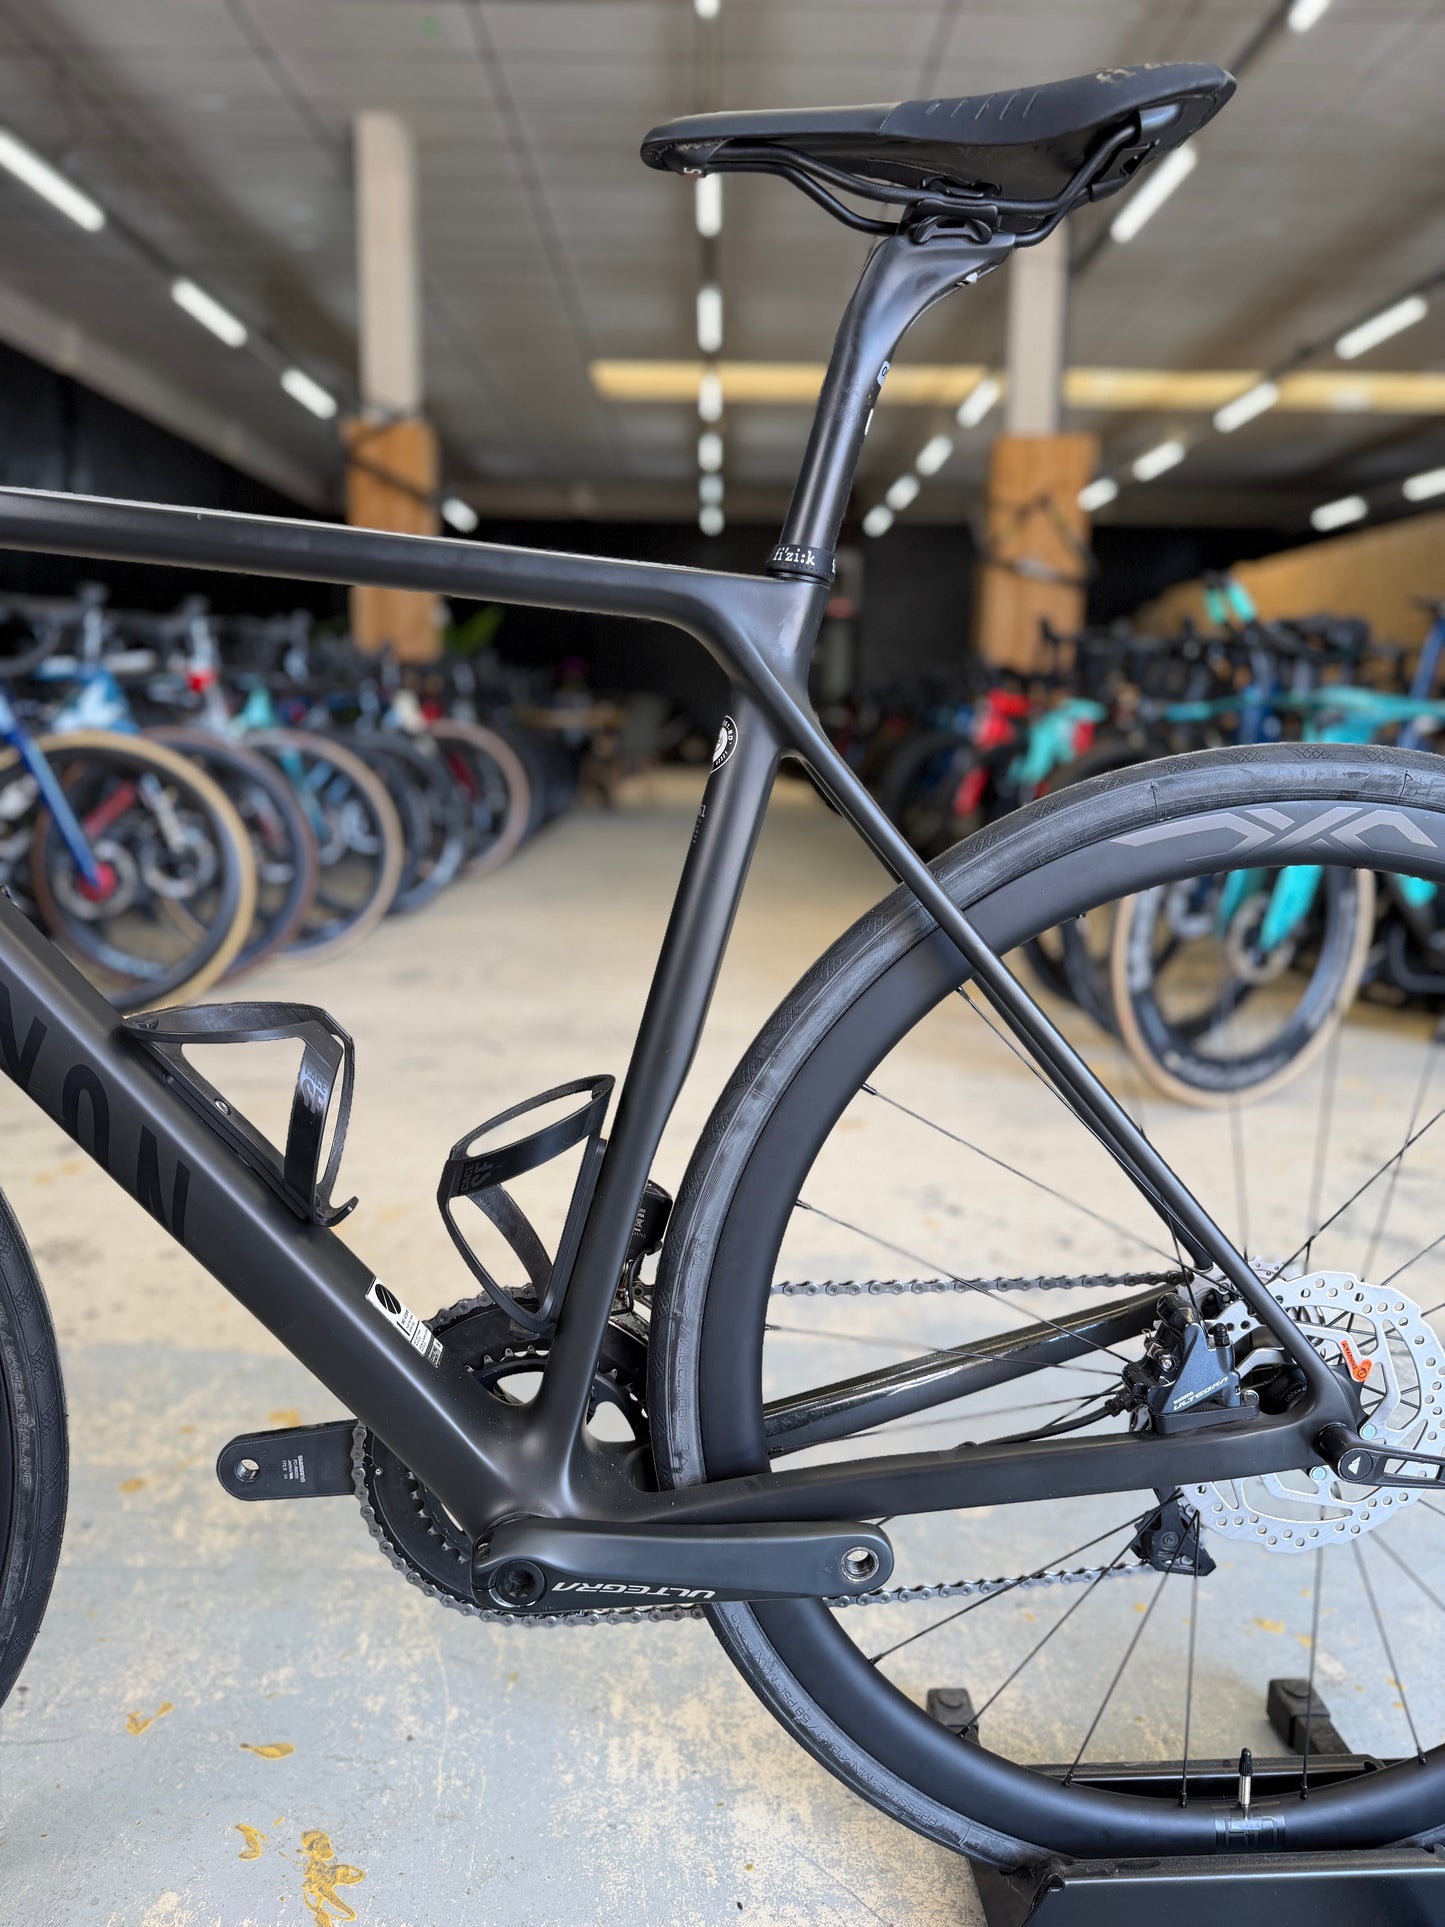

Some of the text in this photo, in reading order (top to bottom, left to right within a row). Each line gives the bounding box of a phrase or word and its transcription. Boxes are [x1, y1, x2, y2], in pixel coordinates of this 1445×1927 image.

[1173, 1376, 1229, 1411] ULTEGRA
[4, 1347, 23, 1391] MADE
[16, 1411, 32, 1486] THAILAND
[552, 1581, 716, 1599] ULTEGRA
[778, 1686, 799, 1709] PSI
[877, 1782, 940, 1827] PRESSURE
